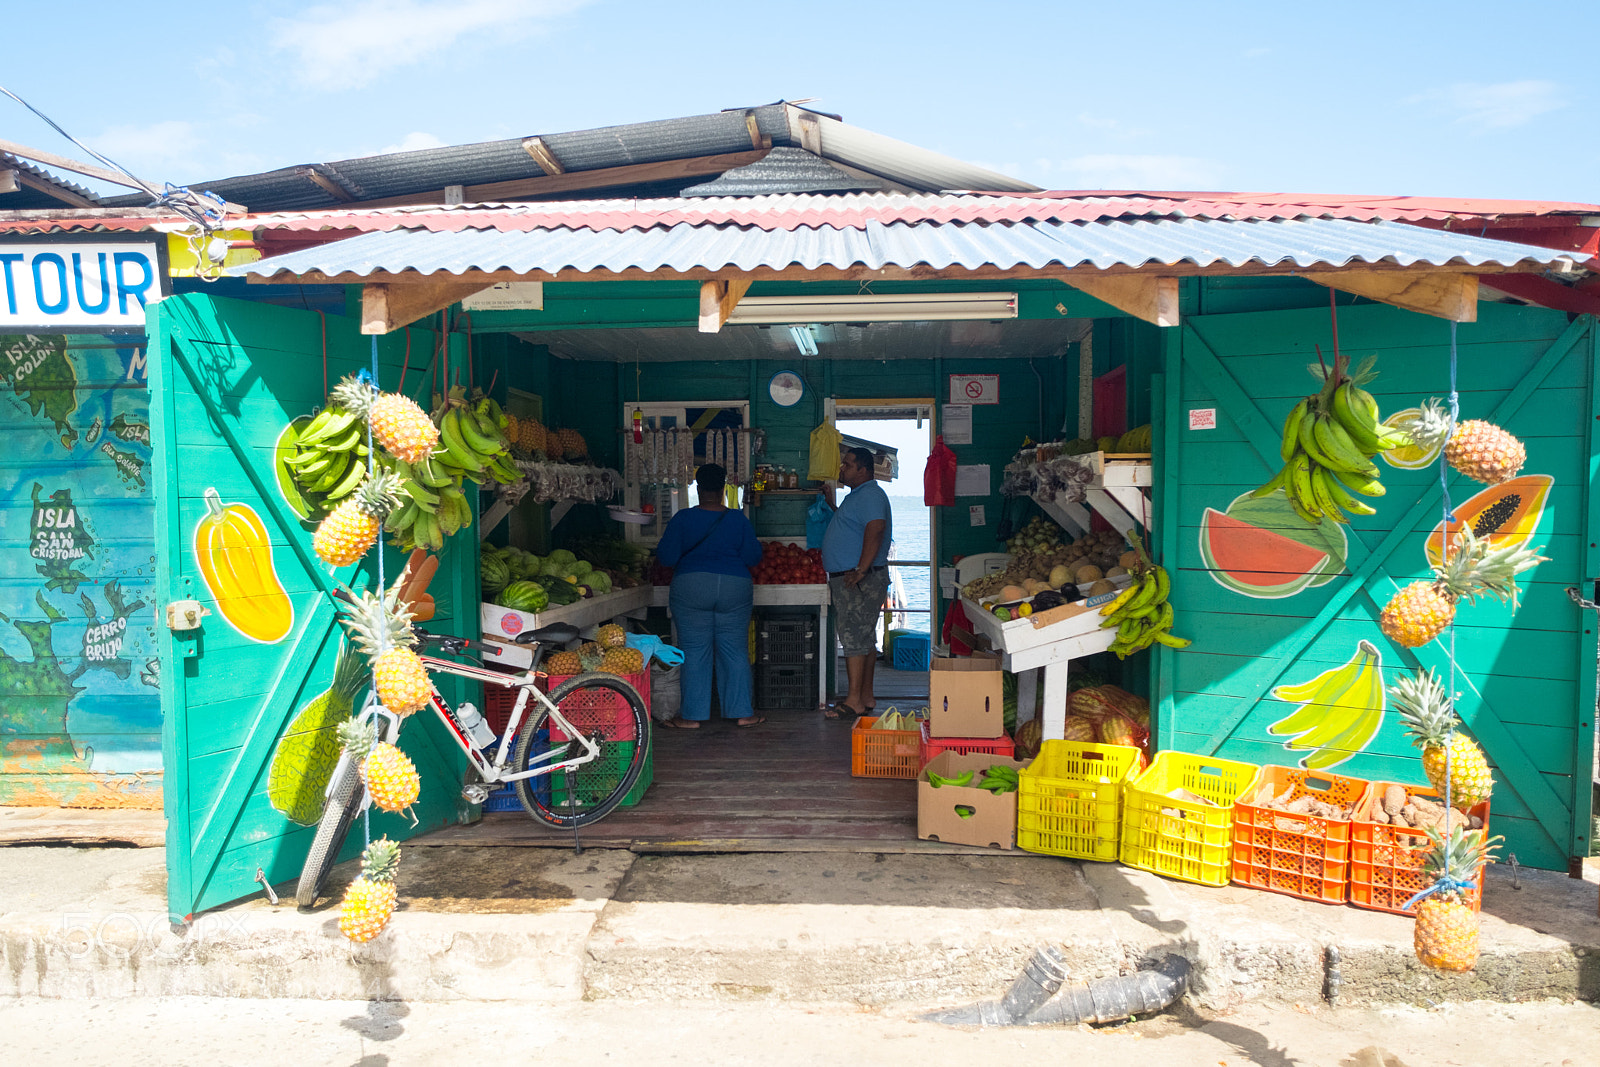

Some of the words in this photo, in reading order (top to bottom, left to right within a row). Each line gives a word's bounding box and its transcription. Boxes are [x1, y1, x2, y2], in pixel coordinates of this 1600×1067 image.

[0, 252, 155, 316] TOUR
[5, 334, 43, 366] ISLA
[121, 426, 149, 441] ISLA
[102, 444, 115, 457] ISLA
[37, 508, 76, 528] ISLA
[36, 531, 75, 549] SAN
[31, 547, 85, 560] CRISTOBAL
[1089, 593, 1115, 606] AMIGO
[86, 617, 127, 643] CERRO
[86, 637, 122, 661] BRUJO
